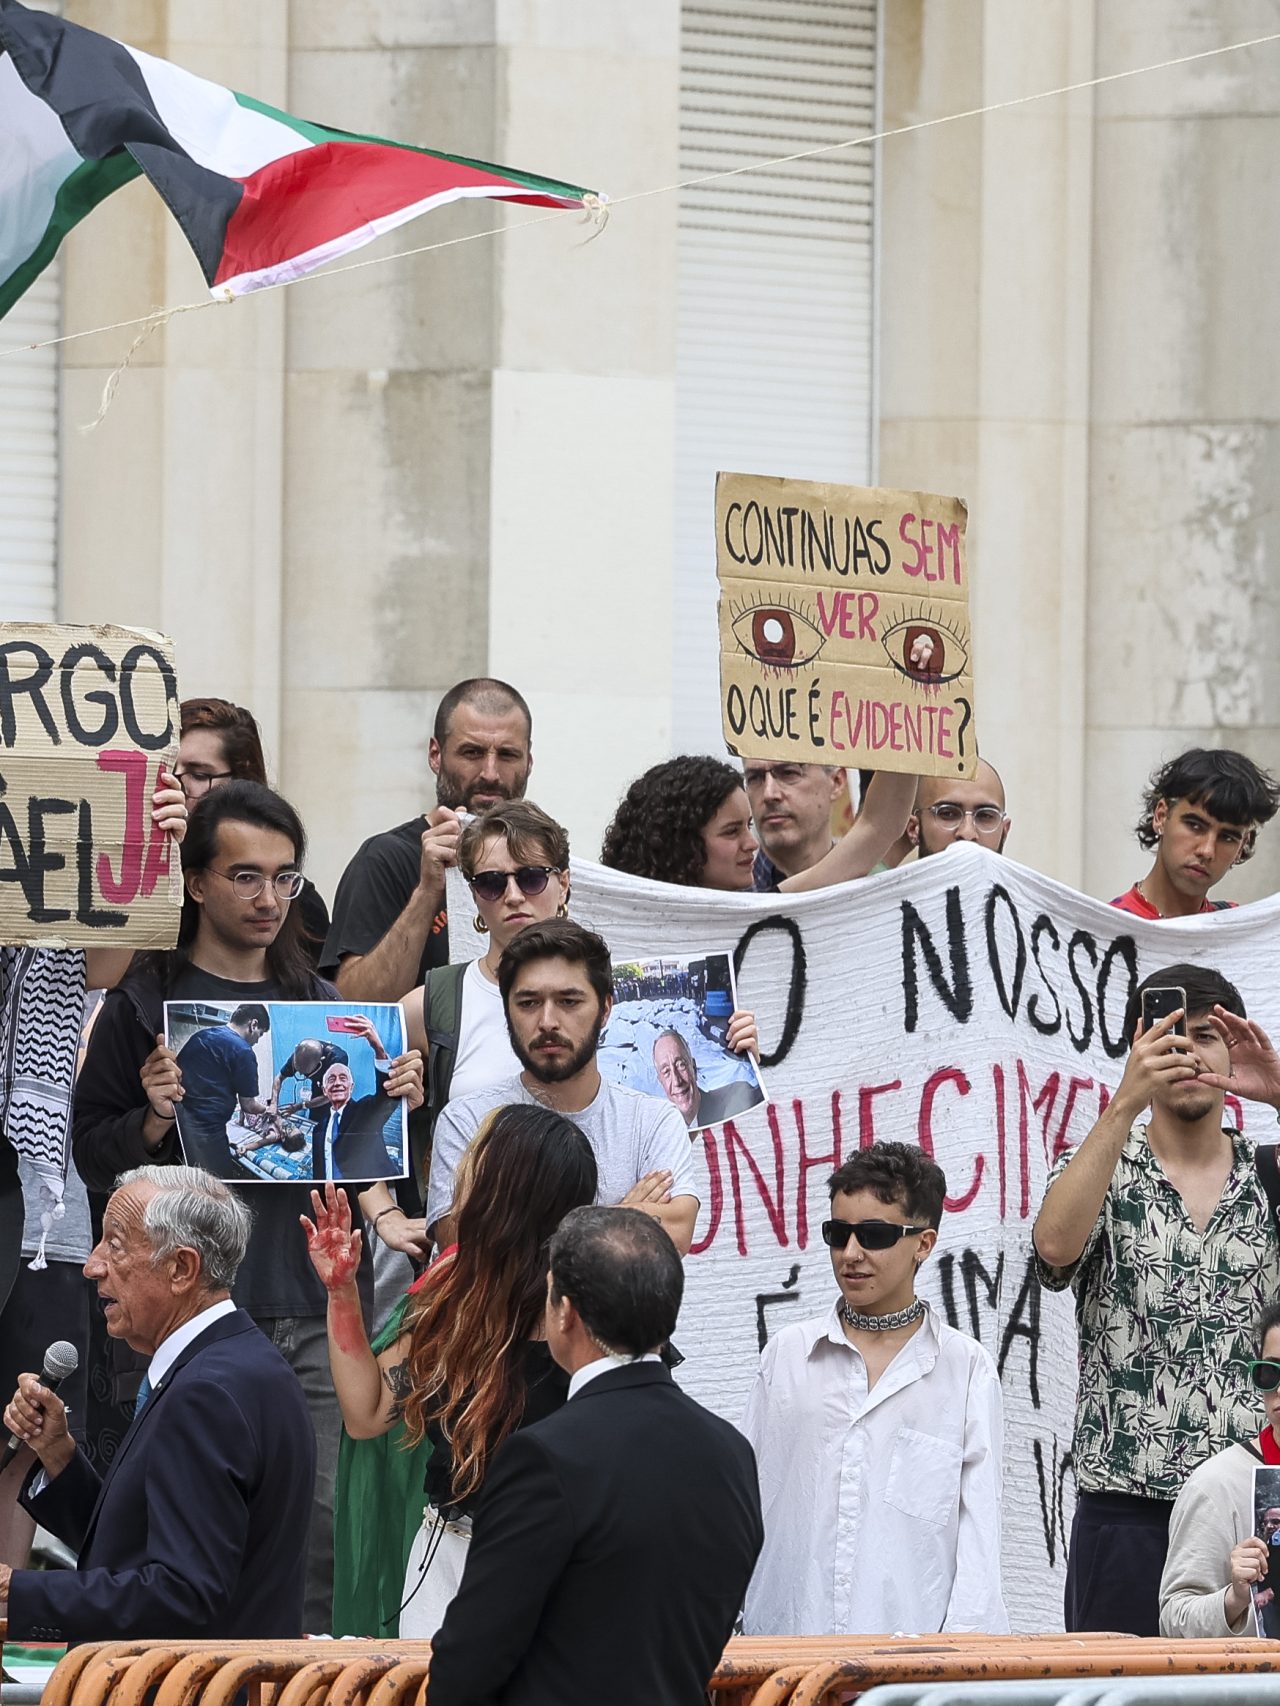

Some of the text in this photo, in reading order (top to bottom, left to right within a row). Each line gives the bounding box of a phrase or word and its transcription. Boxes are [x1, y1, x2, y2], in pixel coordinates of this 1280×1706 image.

[725, 501, 961, 585] CONTINUAS SEM
[817, 591, 879, 642] VER
[727, 678, 971, 772] O QUE É EVIDENTE?
[732, 882, 1140, 1068] O NOSSO
